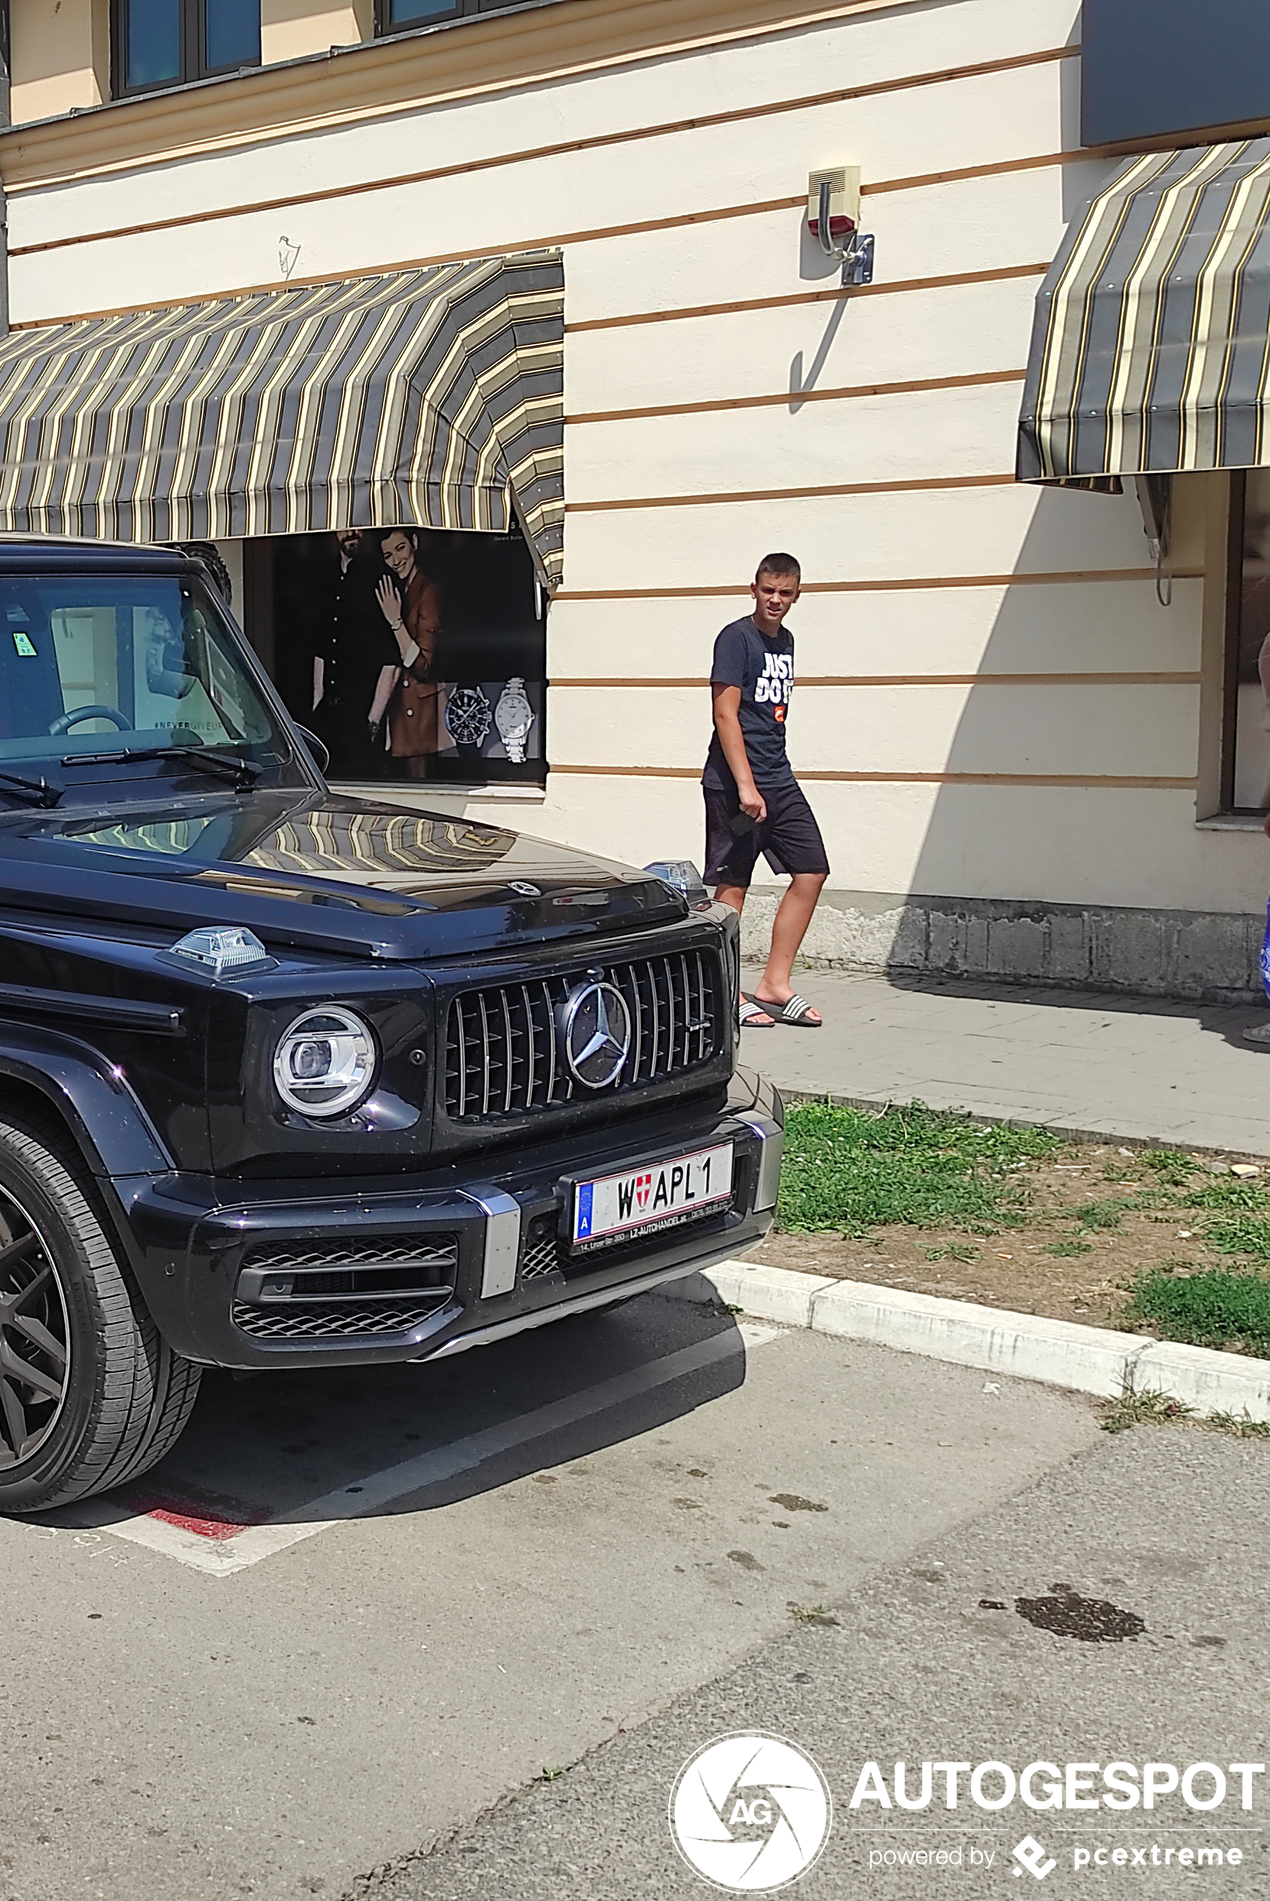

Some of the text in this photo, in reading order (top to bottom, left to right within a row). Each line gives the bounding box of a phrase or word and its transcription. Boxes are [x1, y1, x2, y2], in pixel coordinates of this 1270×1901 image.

[761, 652, 793, 679] JUST
[754, 677, 781, 704] DO
[618, 1156, 711, 1220] W APL 1
[580, 1217, 588, 1230] A
